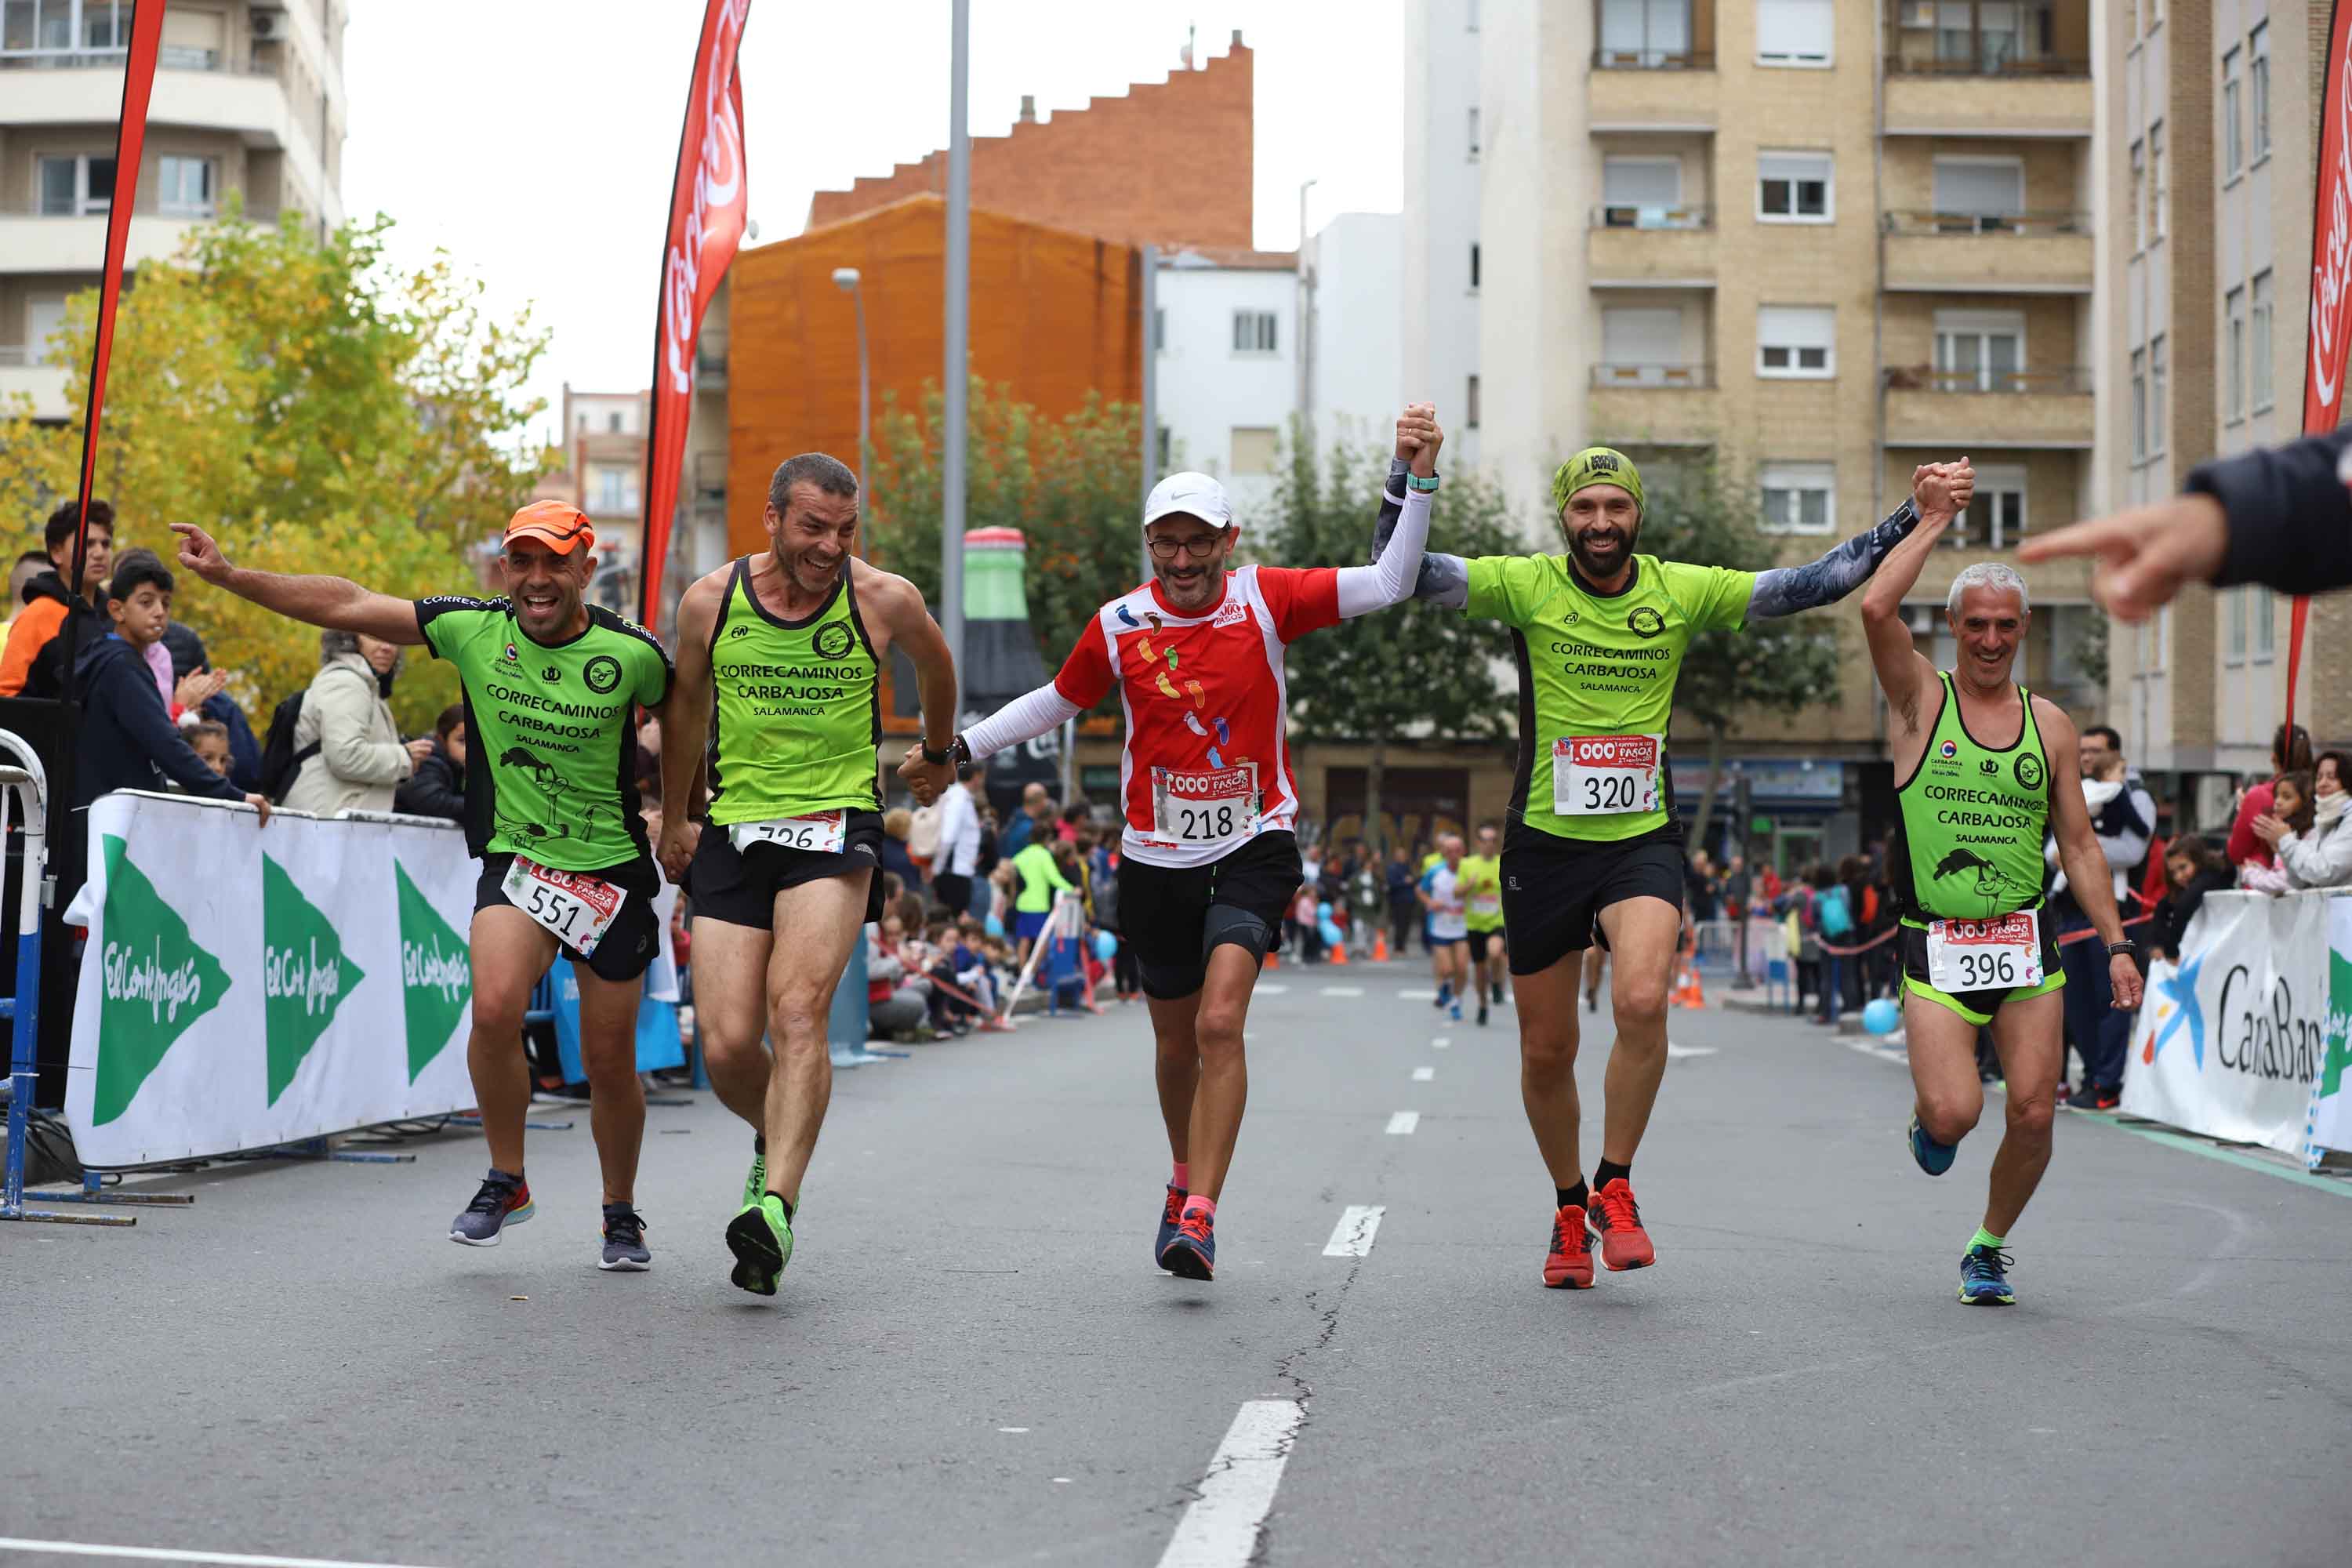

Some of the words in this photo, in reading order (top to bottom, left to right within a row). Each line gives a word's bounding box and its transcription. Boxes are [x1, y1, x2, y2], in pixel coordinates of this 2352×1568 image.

[1551, 642, 1671, 660] CORRECAMINOS
[720, 664, 862, 680] CORRECAMINOS
[1564, 662, 1657, 679] CARBAJOSA
[737, 684, 844, 700] CARBAJOSA
[1580, 682, 1640, 693] SALAMANCA
[486, 683, 619, 720] CORRECAMINOS
[753, 706, 826, 716] SALAMANCA
[499, 710, 601, 739] CARBAJOSA
[514, 733, 580, 753] SALAMANCA
[1620, 746, 1653, 758] PASOS
[1214, 775, 1248, 790] PASOS
[1584, 775, 1635, 810] 320
[1925, 785, 2044, 811] CORRECAMINOS
[1181, 806, 1233, 840] 218
[1937, 811, 2031, 828] CARBAJOSA
[1955, 833, 2017, 844] SALAMANCA
[527, 885, 580, 937] 551
[1991, 924, 2029, 935] PASOS
[1959, 952, 2015, 987] 396
